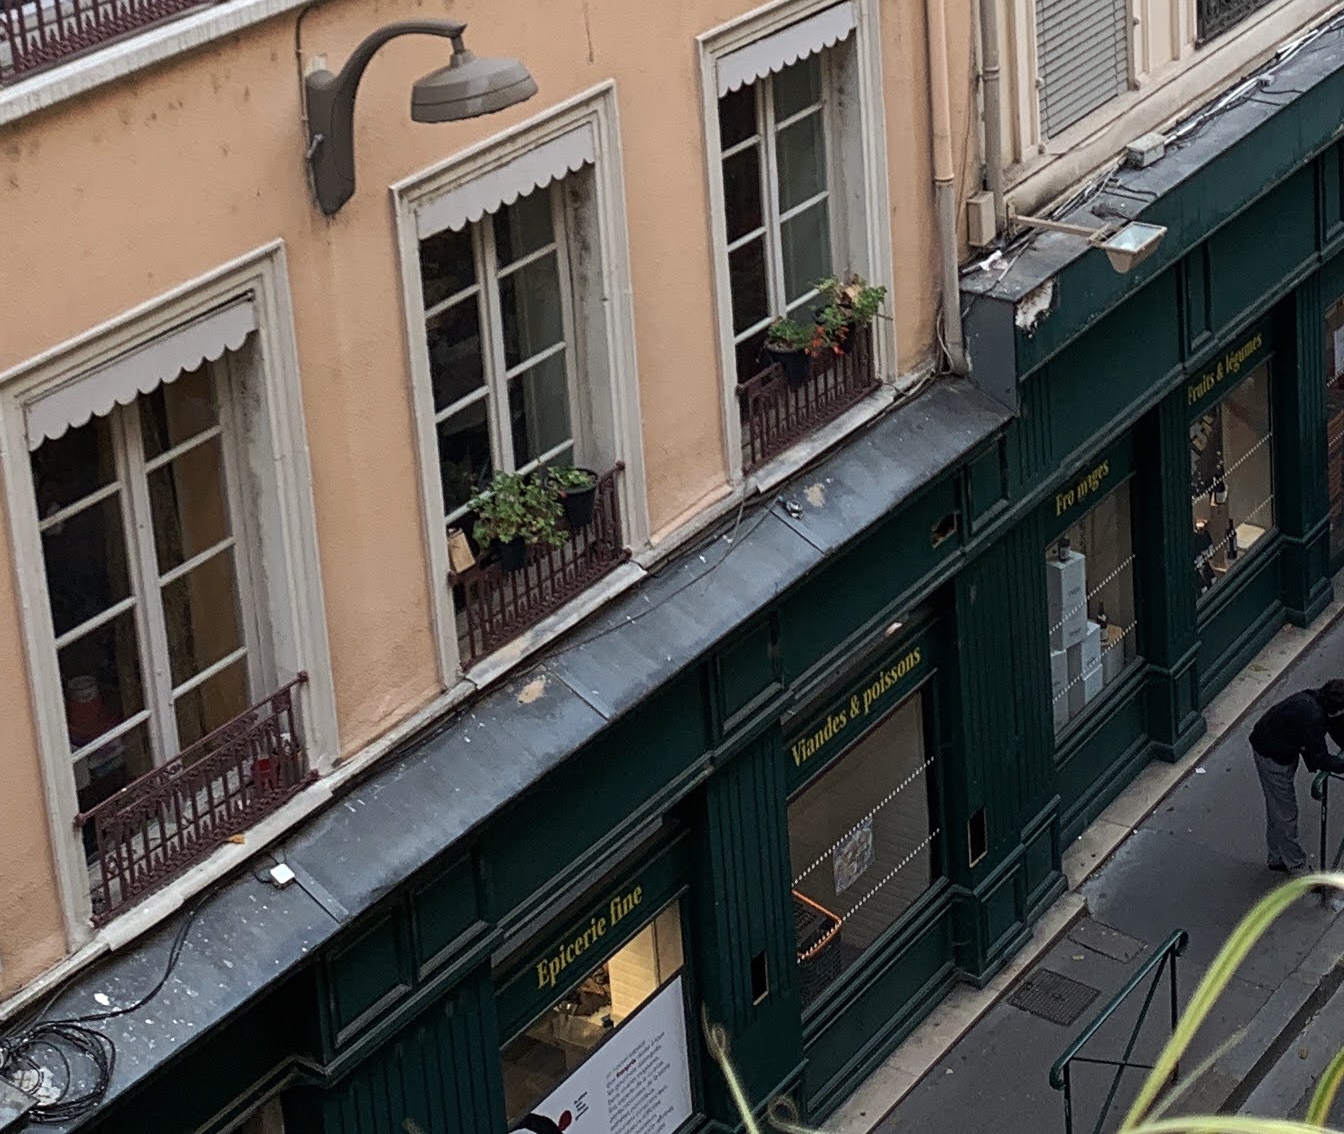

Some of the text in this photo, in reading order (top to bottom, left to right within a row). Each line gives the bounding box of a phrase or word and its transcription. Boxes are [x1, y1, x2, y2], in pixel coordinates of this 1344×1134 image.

[1188, 333, 1263, 406] Fruits & légumes
[791, 646, 922, 767] Viandes & poissons
[536, 885, 643, 990] Epicerie fine
